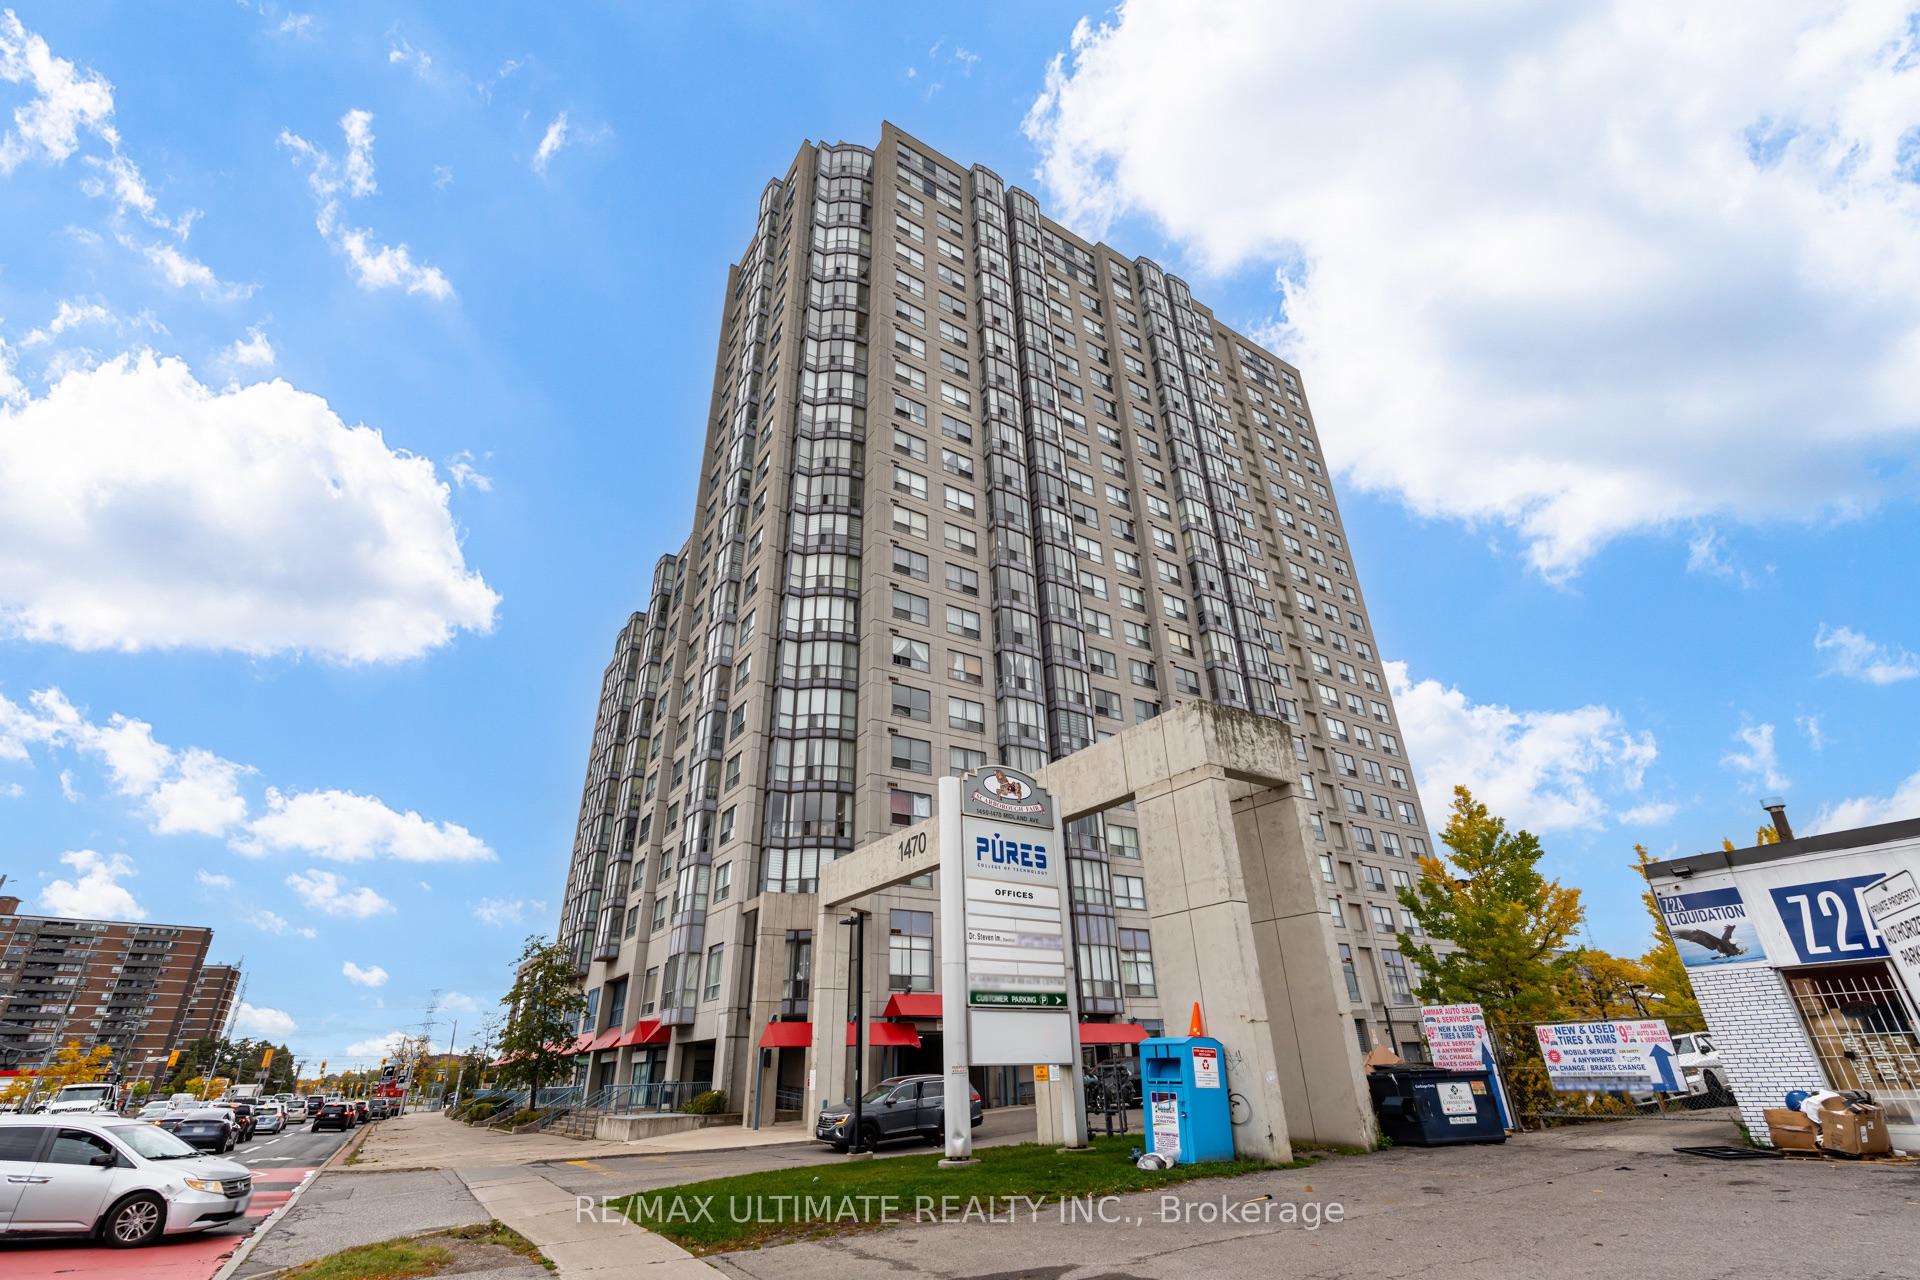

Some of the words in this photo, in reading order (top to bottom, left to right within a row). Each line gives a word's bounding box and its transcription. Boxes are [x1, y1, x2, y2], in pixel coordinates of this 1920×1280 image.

[1003, 812, 1028, 823] MIDLAND
[898, 832, 926, 862] 1470
[1013, 867, 1048, 876] TECHNOLOGY
[995, 888, 1034, 899] OFFICES
[1662, 897, 1686, 912] Z2A
[1870, 899, 1889, 916] PRIVATE
[1889, 887, 1916, 910] PROPERTY
[1667, 904, 1746, 926] LIQUIDATION
[1884, 915, 1920, 945] AUTHORIZE
[968, 932, 977, 940] Dr.
[977, 933, 994, 942] Steven
[1554, 1026, 1575, 1035] NEW
[1579, 1025, 1586, 1034] &
[1588, 1024, 1615, 1034] USED
[1558, 1036, 1584, 1045] TIRES
[1586, 1035, 1593, 1044] &
[1594, 1034, 1617, 1044] RIMS
